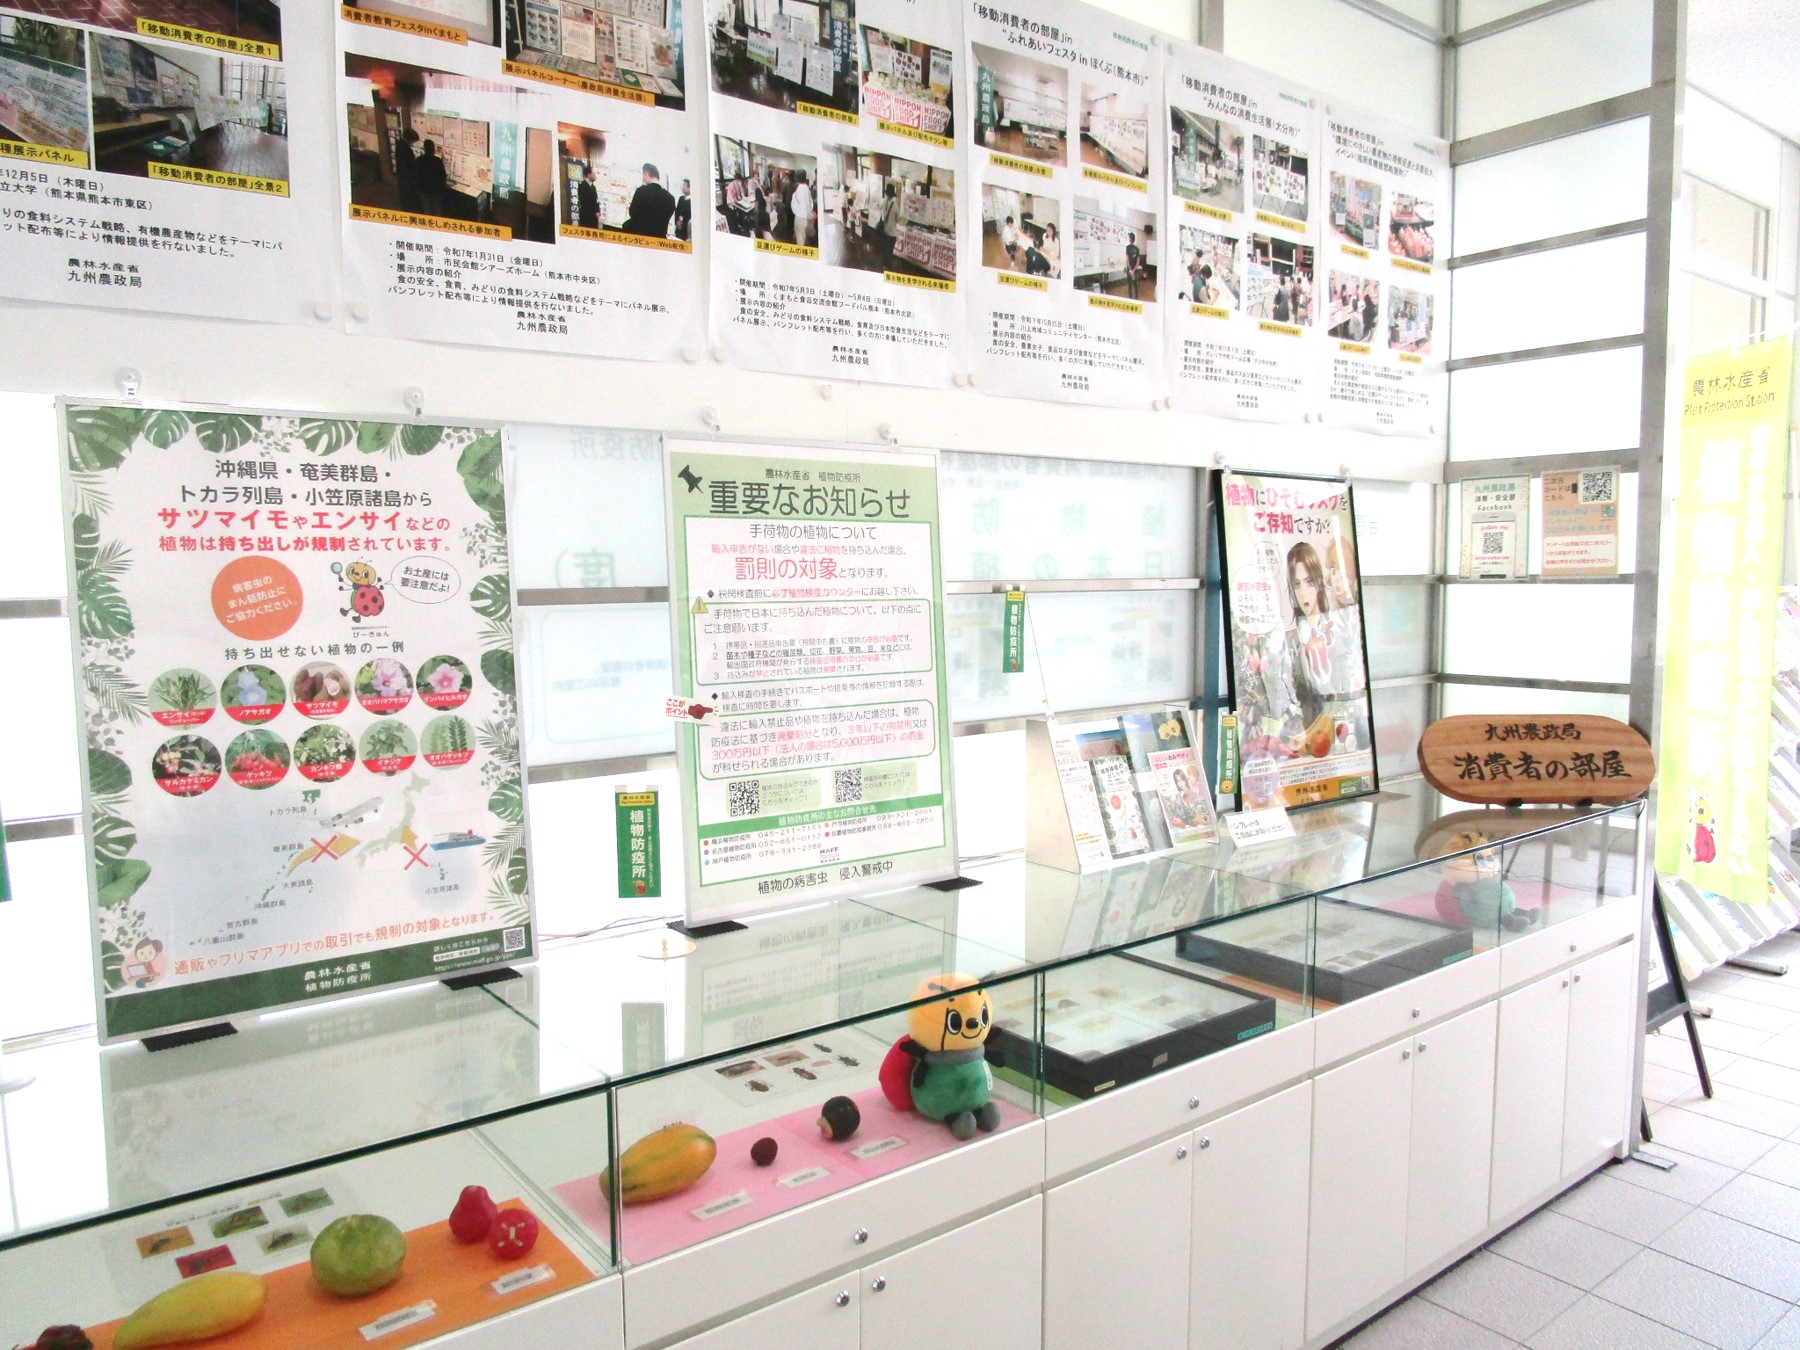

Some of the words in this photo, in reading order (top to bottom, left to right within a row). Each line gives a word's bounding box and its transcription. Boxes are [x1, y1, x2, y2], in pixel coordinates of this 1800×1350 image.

[343, 9, 462, 42] 消費者教育フェスタinくまもと
[972, 2, 1073, 45] 「移動消費者の部屋」in
[140, 22, 273, 56] 「移動消費者の部屋」全景1
[924, 106, 951, 119] NIPPON
[152, 165, 283, 193] 「移動消費者の部屋」全景2
[352, 207, 502, 237] 展示パネルに興味をしめされる参加者
[756, 241, 817, 257] 豆運びゲームの様子
[68, 258, 139, 274] 農林水産省
[67, 270, 142, 289] 九州農政局
[516, 310, 567, 323] 農林水産省
[516, 321, 569, 336] 九州農政局
[832, 353, 870, 366] 九州農政局
[765, 468, 810, 481] 農林水産省
[818, 471, 861, 483] 植物防疫所
[180, 485, 434, 508] トカラ列島・小笠原諸島から
[1544, 485, 1571, 493] コードは
[709, 479, 911, 518] 重要なお知らせ
[1477, 504, 1512, 512] Facebook
[157, 507, 451, 532] サツマイモやエンサイなどの
[1253, 510, 1331, 535] ご存知ですか？
[750, 523, 877, 540] 手荷物の植物について
[159, 535, 451, 553] 植物は持ち出しが規制されています。
[403, 565, 450, 582] お土産には
[734, 556, 889, 580] 罰則の対象となります。
[231, 574, 273, 595] 病害虫の
[400, 577, 451, 594] 要注意だよ！
[227, 586, 287, 609] まん延防止に
[225, 640, 405, 661] 持ち出せない植物の一例
[306, 701, 339, 709] サツマイモ
[666, 698, 686, 707] ここが
[238, 708, 272, 717] ノアサガオ
[665, 707, 688, 717] ポイント
[1484, 722, 1582, 742] 九州農政局
[378, 757, 402, 765] イチジク
[1453, 749, 1633, 782] 消費者の部屋
[164, 775, 214, 787] サルカケミカン
[270, 805, 307, 816] トカラ列島
[629, 809, 646, 879] 植物防疫所
[819, 846, 840, 855] MAFF
[758, 871, 829, 895] 植物の病害虫
[839, 860, 893, 881] 侵入警戒中
[424, 883, 460, 896] 小笠原諸島
[173, 910, 495, 977] 通販やフリマアプリでの取引でも規制の対象となります。
[304, 961, 372, 982] 農林水産省
[305, 972, 372, 994] 植物防疫所
